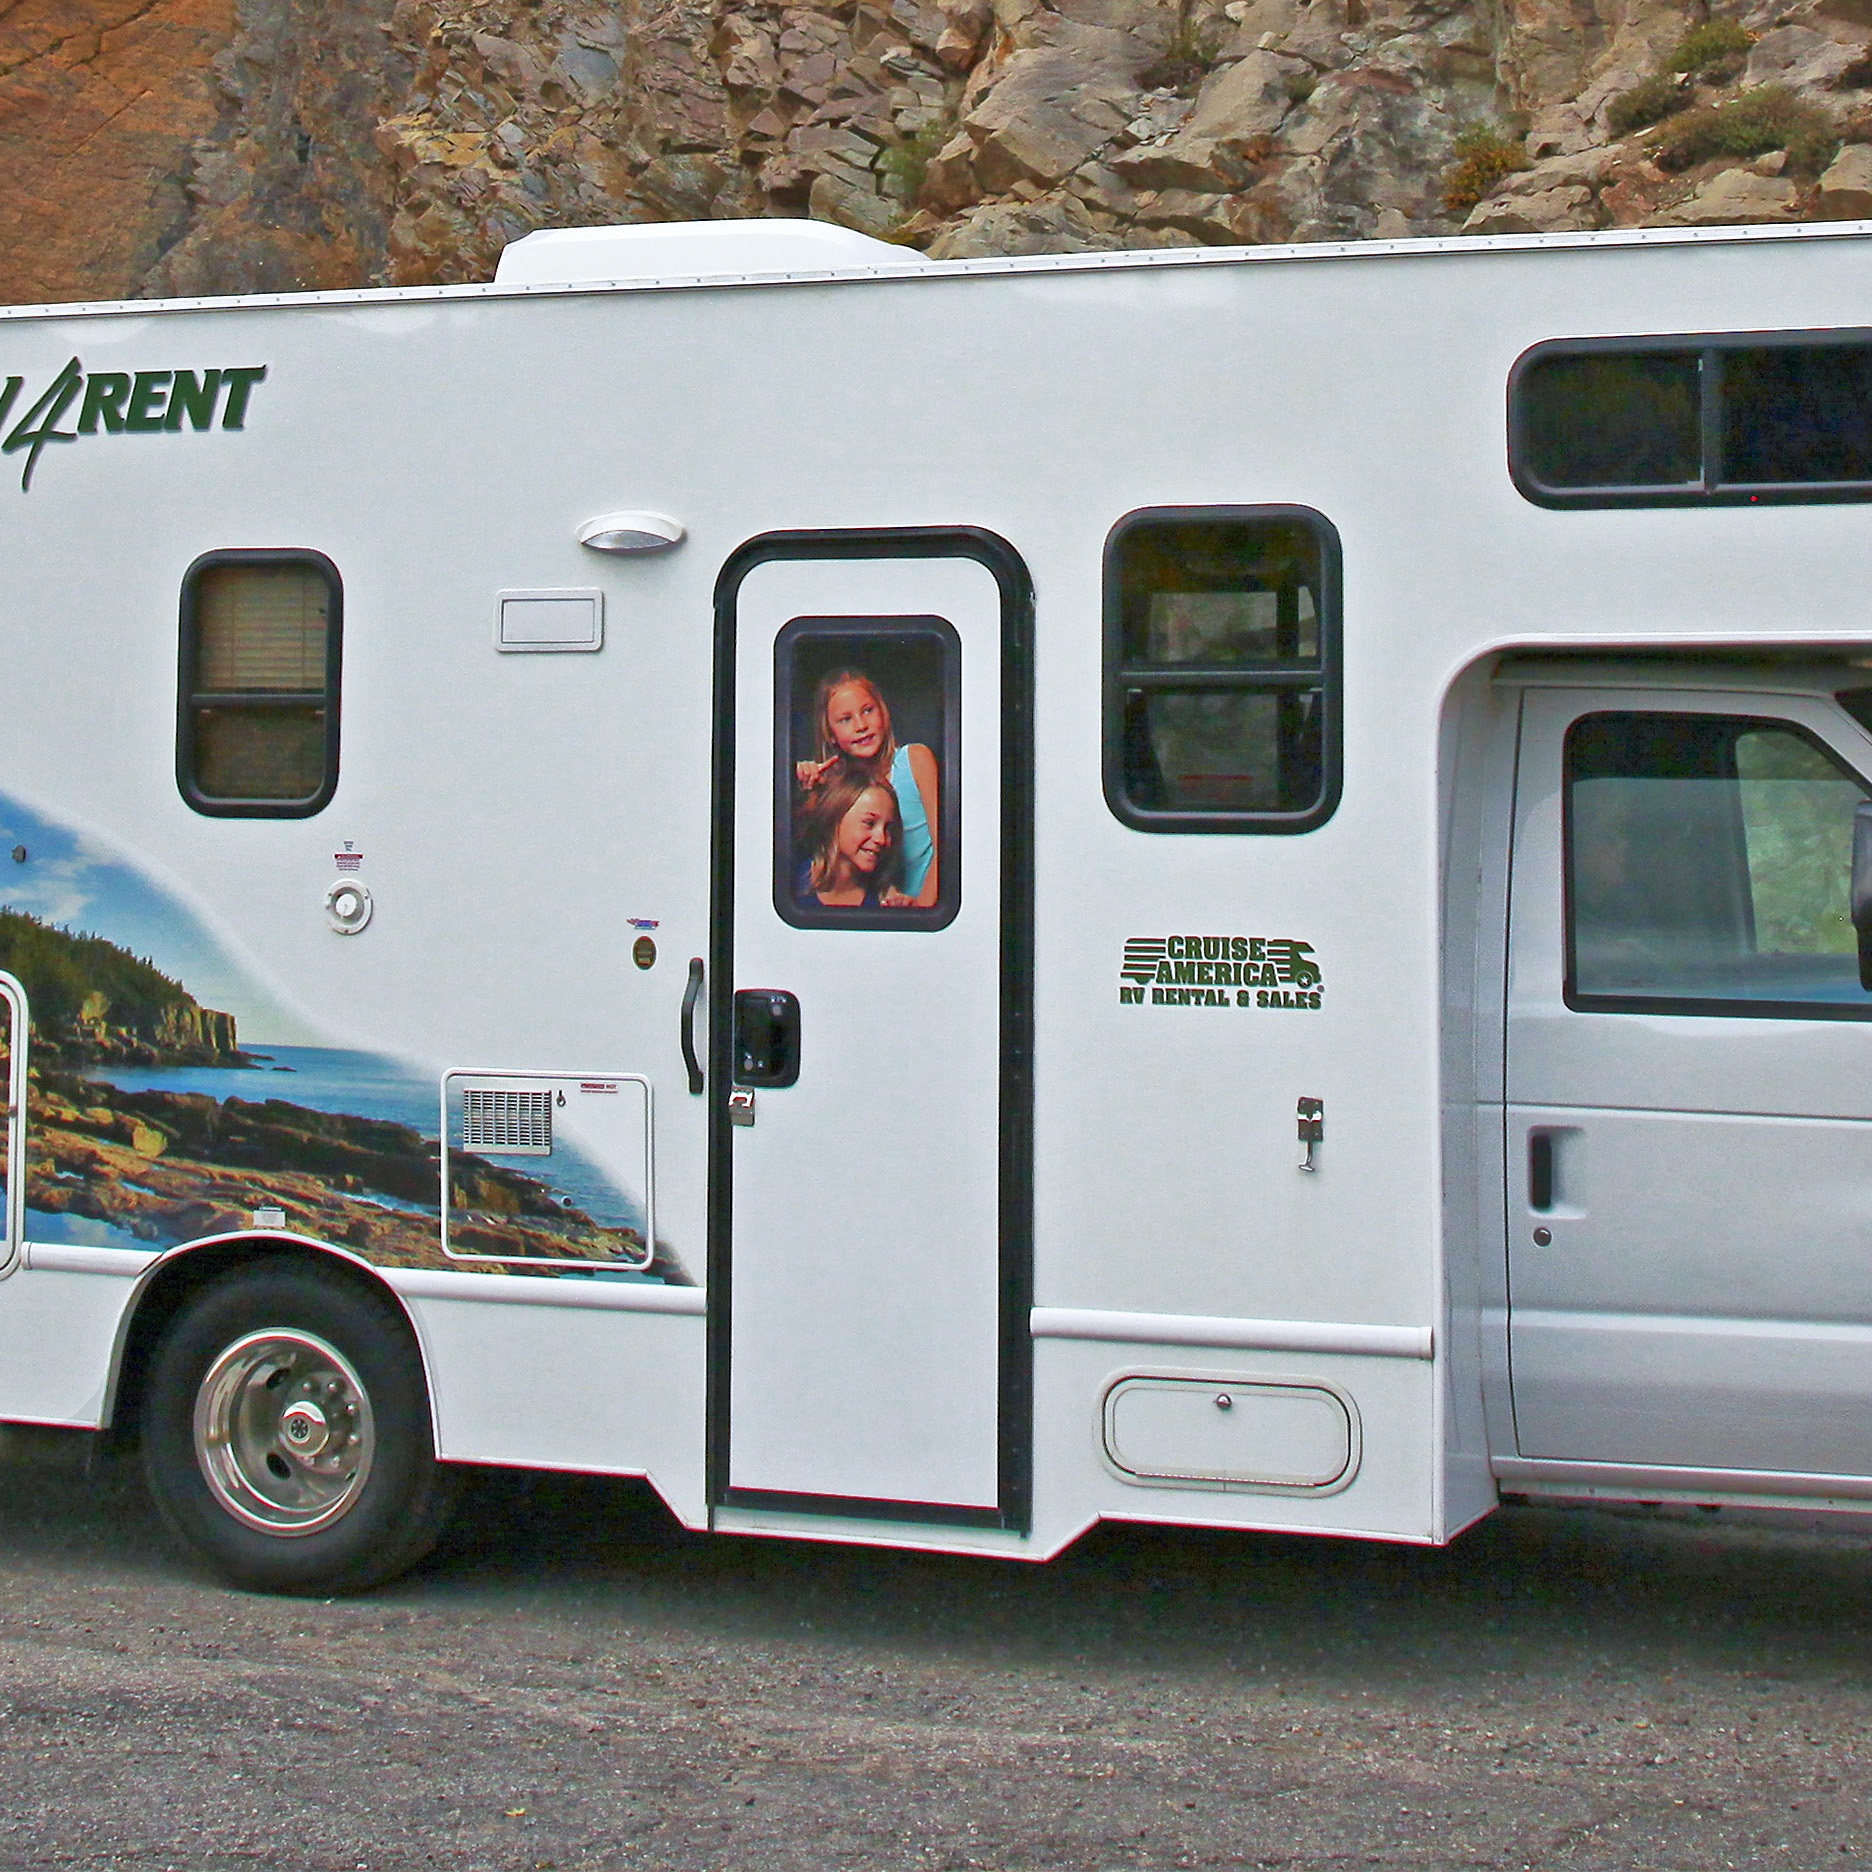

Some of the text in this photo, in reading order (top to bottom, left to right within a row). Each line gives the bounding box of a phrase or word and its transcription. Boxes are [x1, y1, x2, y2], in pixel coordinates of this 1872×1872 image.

[1167, 935, 1267, 961] CRUISE
[1155, 960, 1278, 987] AMERICA
[1120, 986, 1322, 1010] RV RENTAL & SALES
